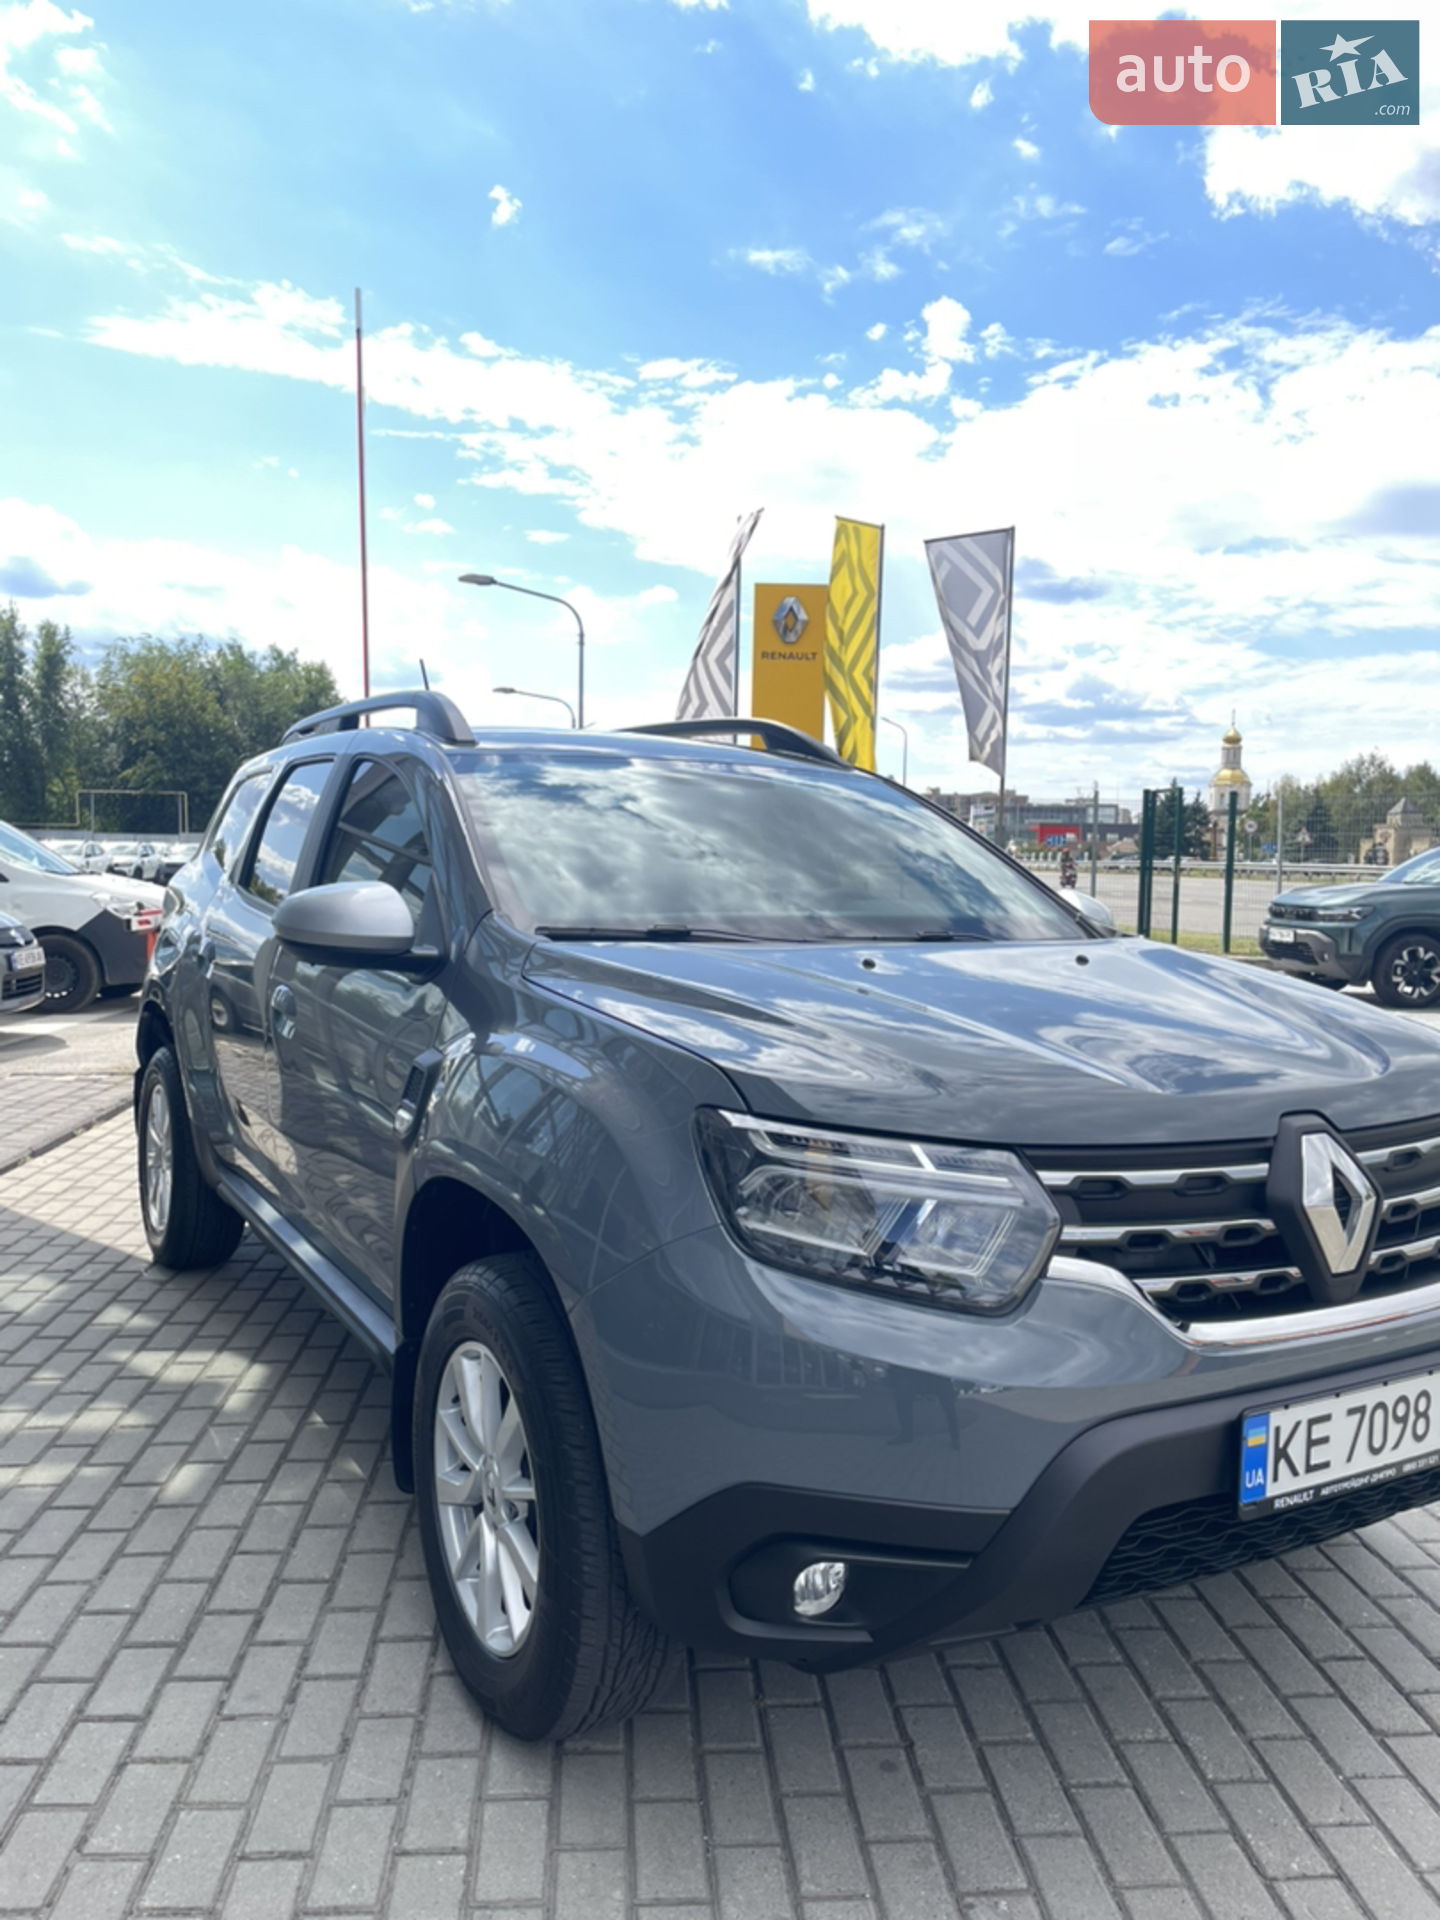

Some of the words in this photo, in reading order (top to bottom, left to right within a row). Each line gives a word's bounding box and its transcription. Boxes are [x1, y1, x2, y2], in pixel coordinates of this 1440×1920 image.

[761, 651, 818, 661] RENAULT
[1272, 1413, 1333, 1483] KE
[1346, 1389, 1432, 1464] 7098
[1245, 1467, 1265, 1488] UA
[1273, 1489, 1315, 1510] RENAULT
